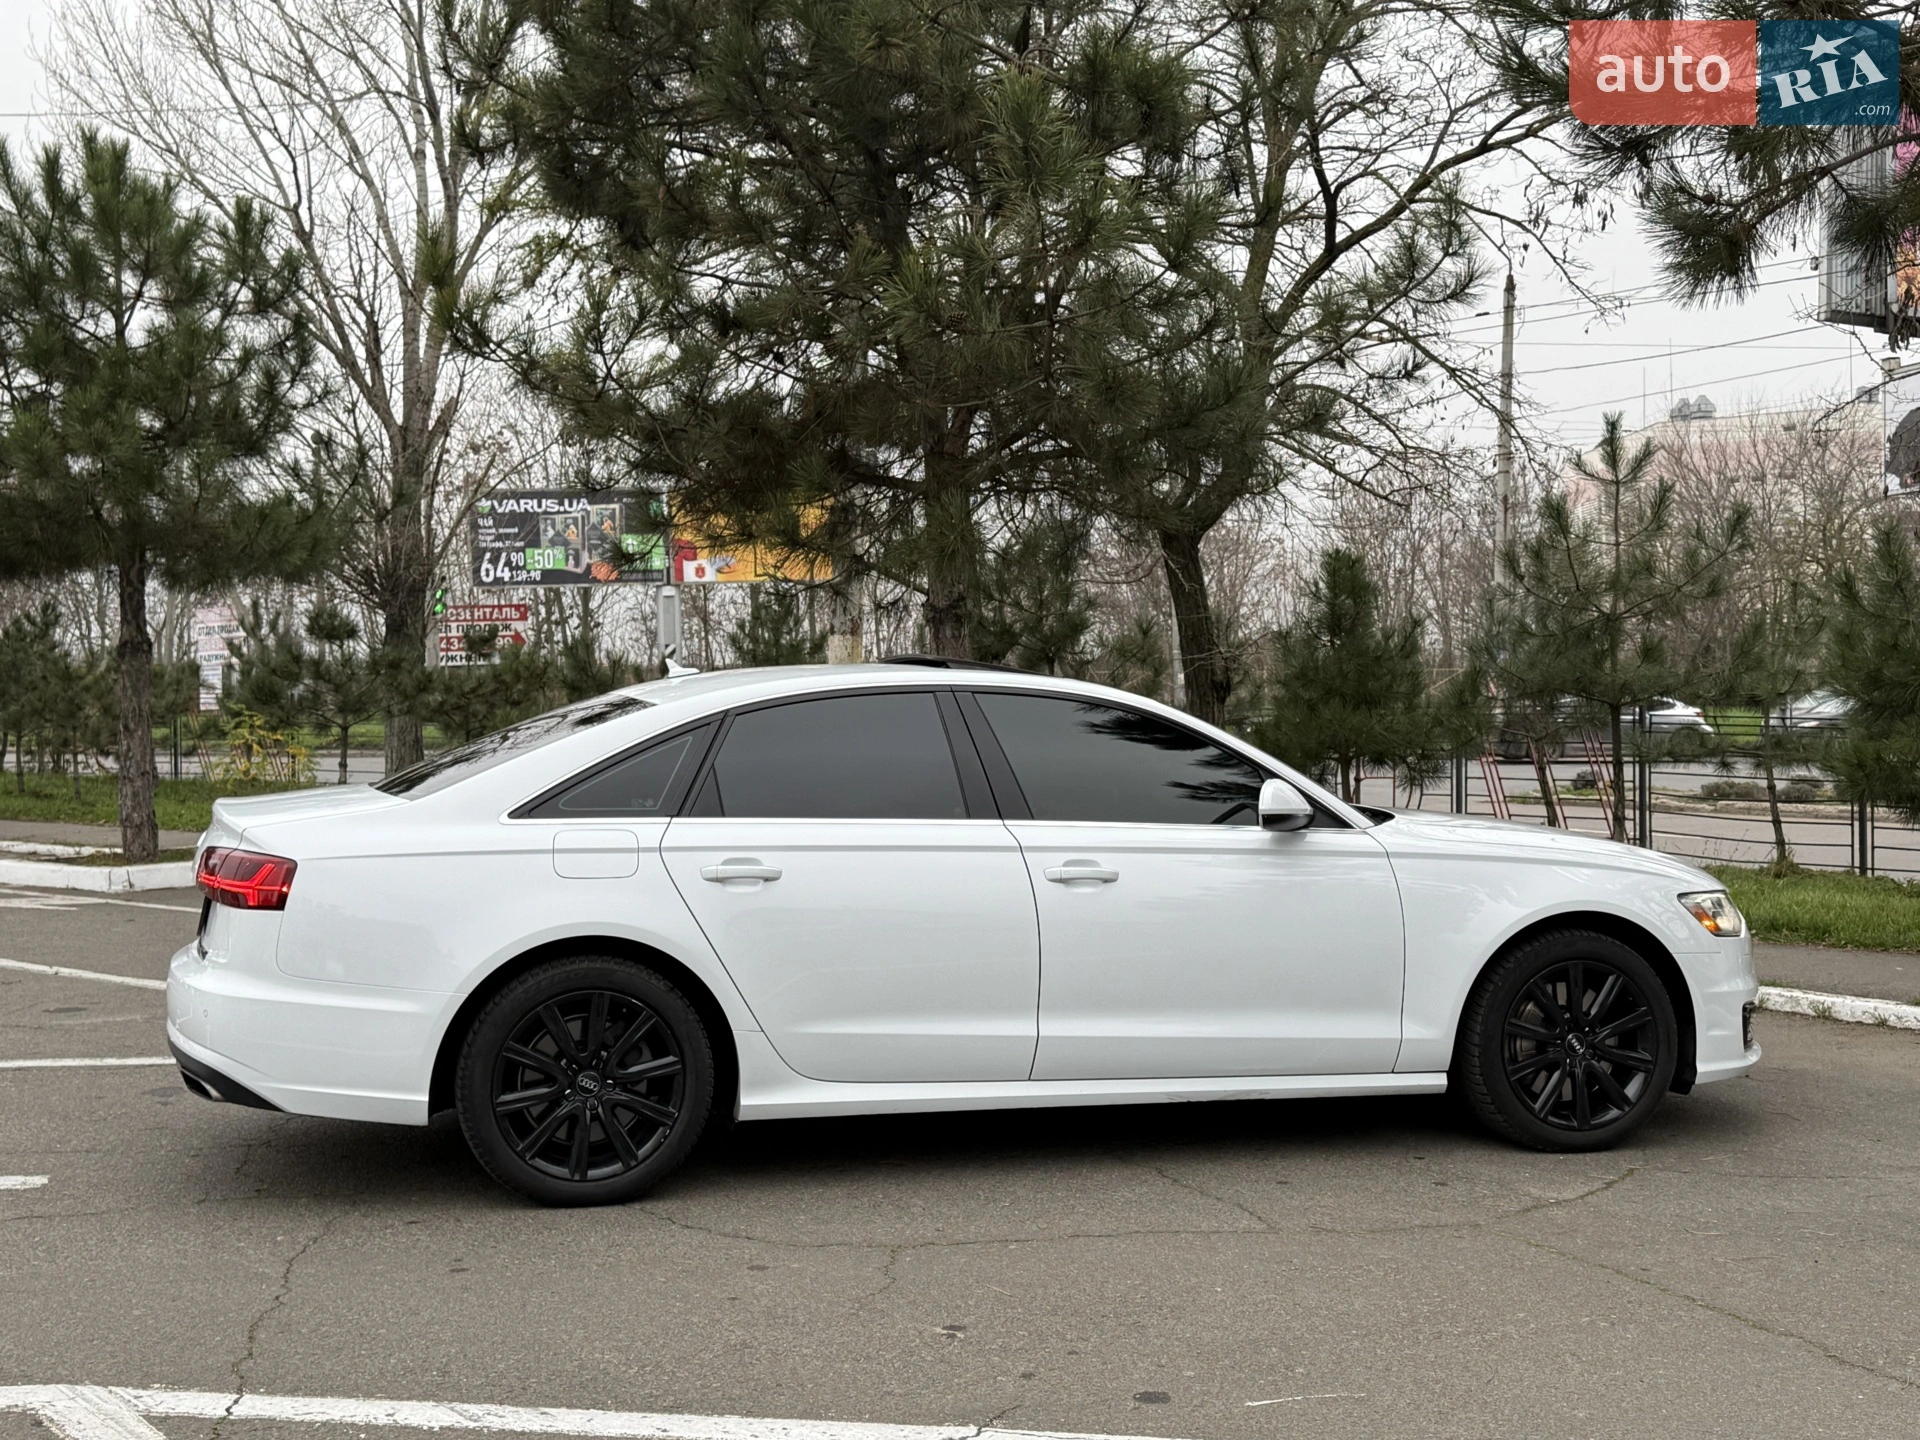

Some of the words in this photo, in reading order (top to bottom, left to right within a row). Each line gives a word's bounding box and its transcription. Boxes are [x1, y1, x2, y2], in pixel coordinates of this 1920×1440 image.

[493, 497, 592, 513] VARUS.UA
[480, 552, 511, 583] 64
[510, 552, 525, 567] 90
[457, 622, 512, 634] ПРОДЖ
